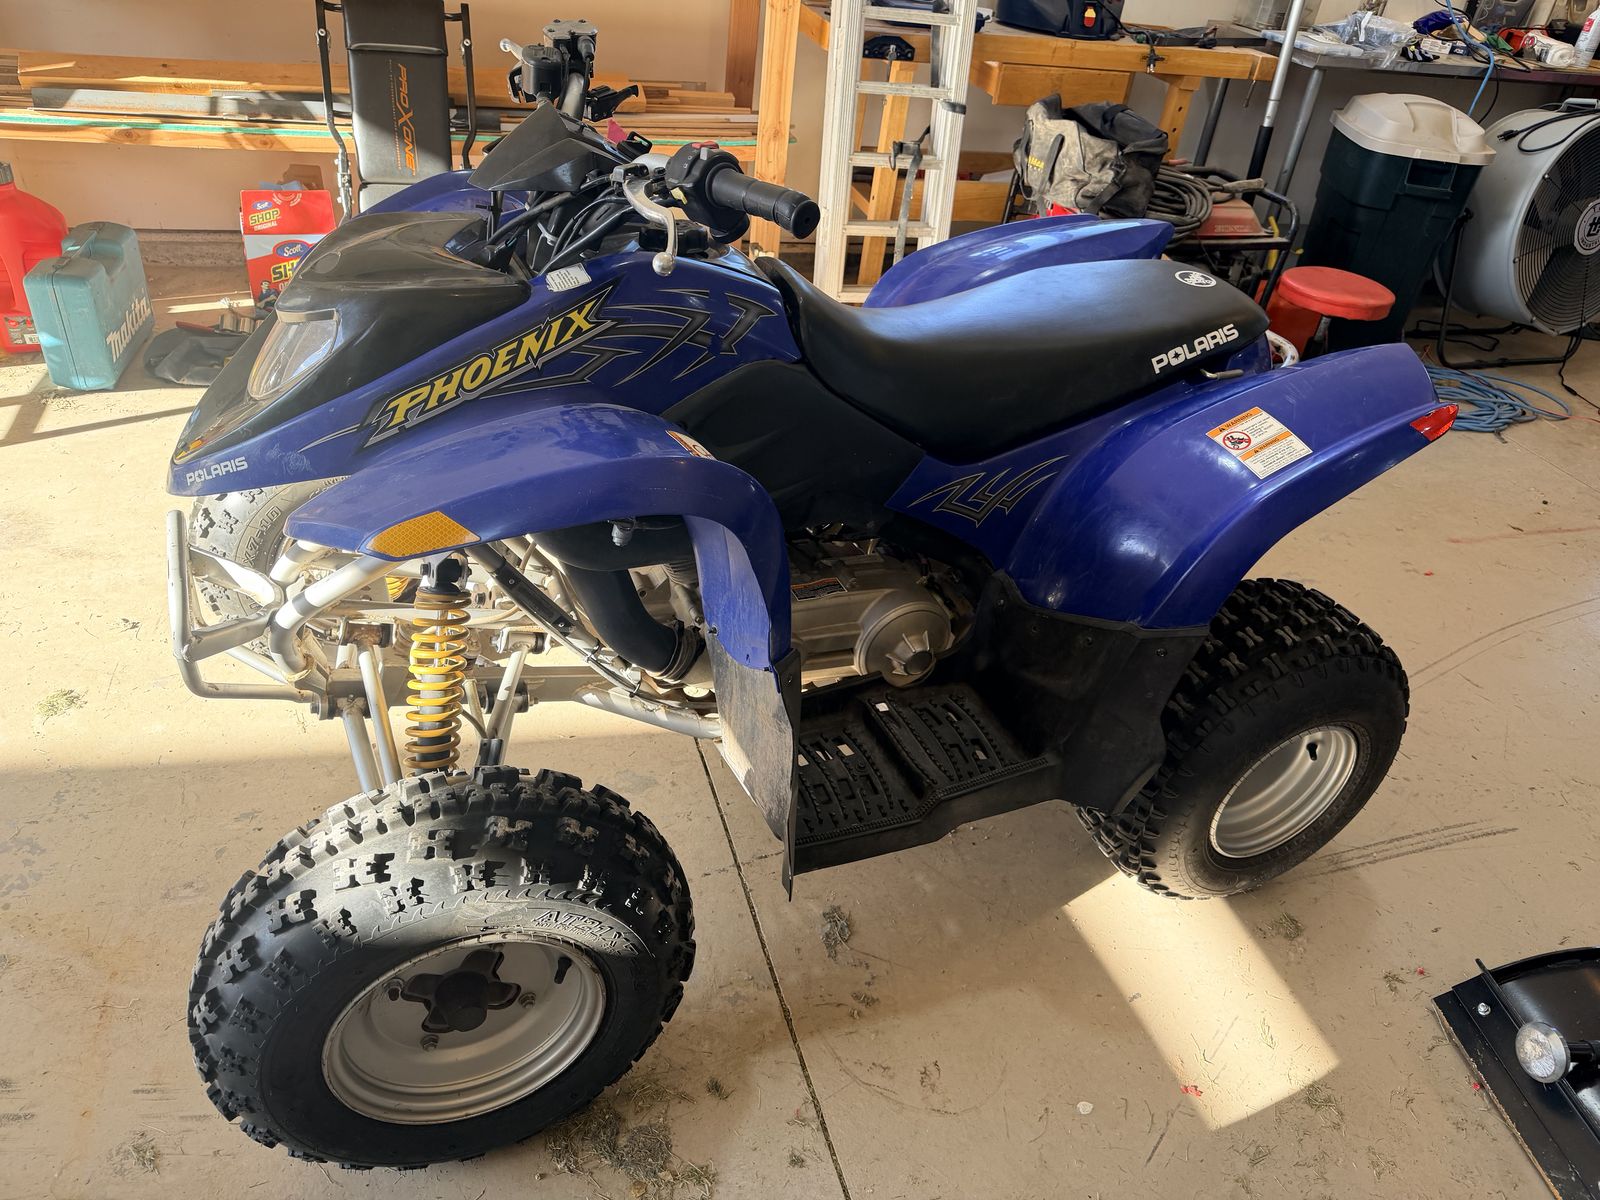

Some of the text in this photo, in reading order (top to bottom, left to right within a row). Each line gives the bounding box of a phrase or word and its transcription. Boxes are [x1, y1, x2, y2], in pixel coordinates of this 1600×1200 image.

[249, 209, 280, 226] SHOP
[284, 244, 303, 257] Scott
[271, 258, 298, 283] SH
[1151, 323, 1239, 375] POLARIS
[386, 298, 598, 428] PHOENIX
[1224, 412, 1253, 430] WARNING
[1259, 437, 1280, 450] WARNING
[185, 455, 248, 486] POLARIS
